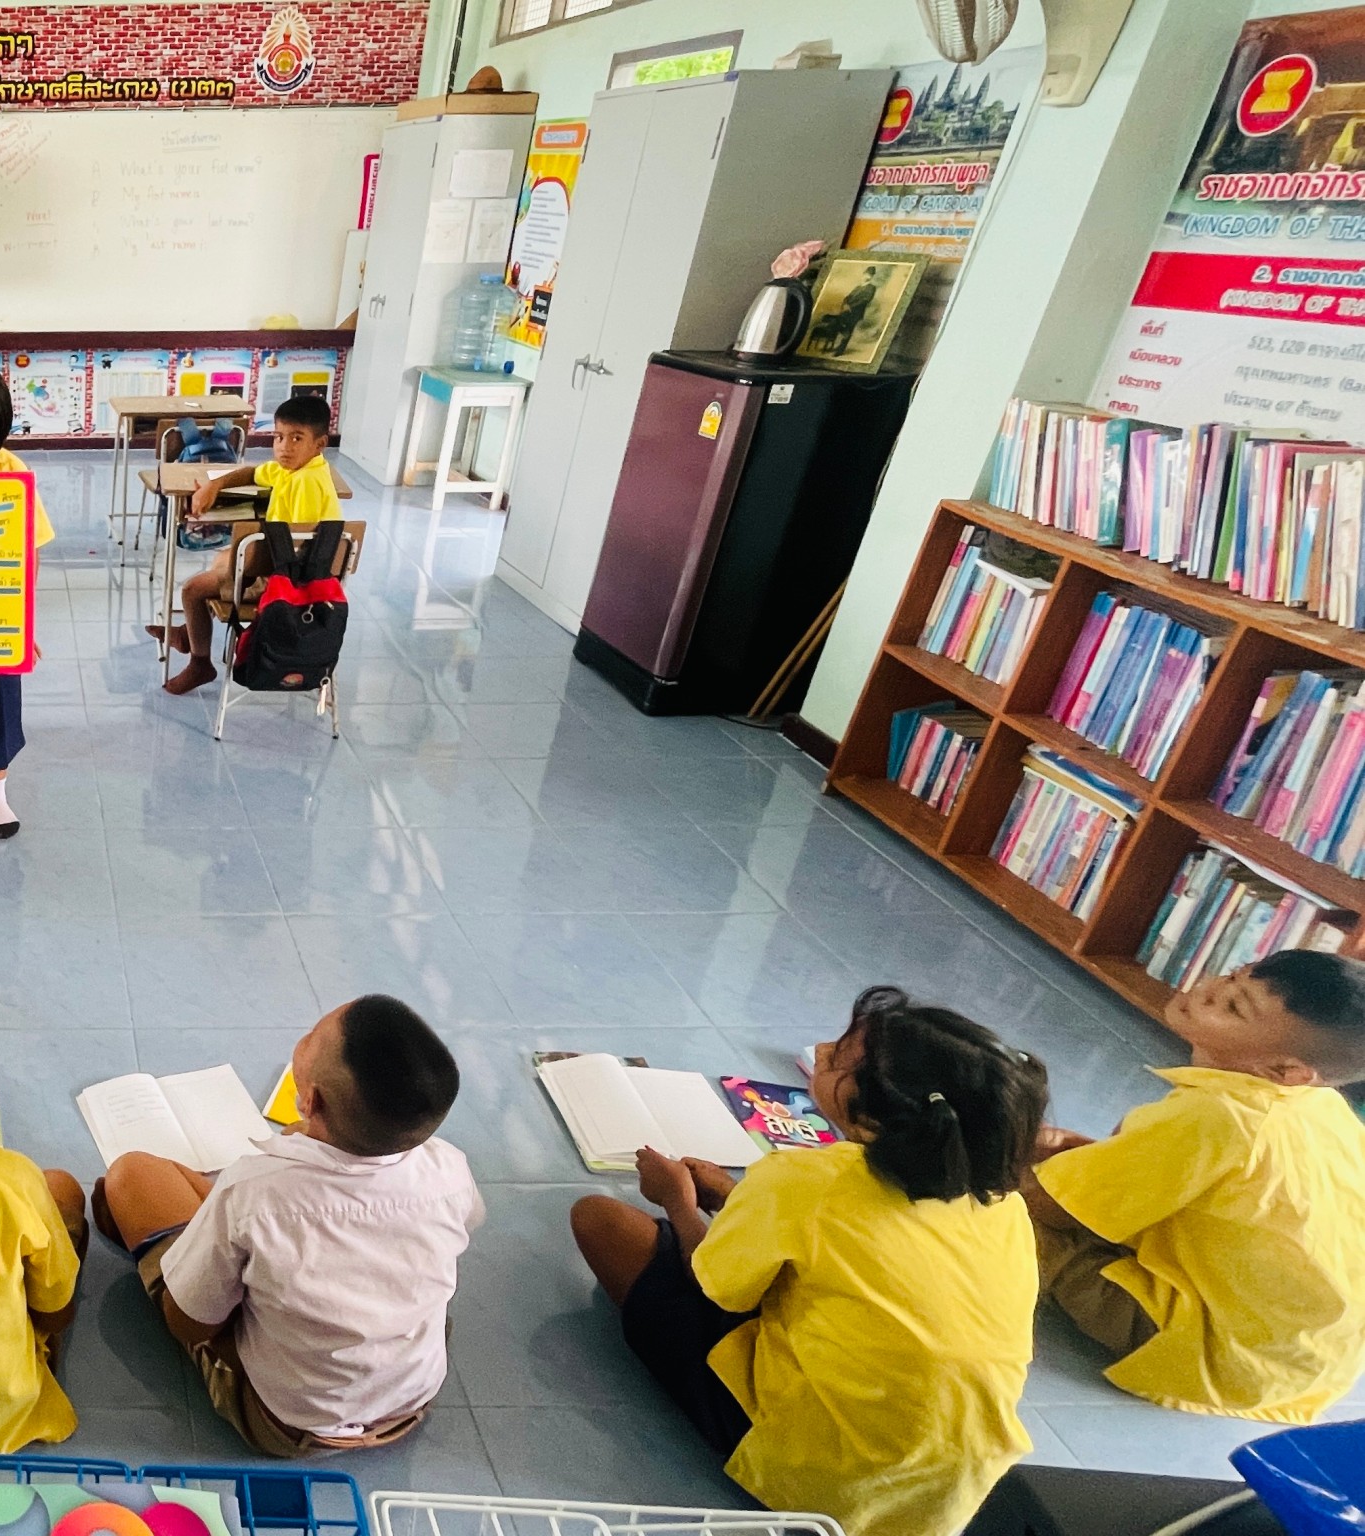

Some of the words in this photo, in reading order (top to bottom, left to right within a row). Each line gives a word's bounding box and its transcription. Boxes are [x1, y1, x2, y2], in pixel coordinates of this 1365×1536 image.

[174, 162, 202, 185] your
[1198, 166, 1365, 200] ราชอาณาจักร
[861, 195, 896, 212] GDOM
[1183, 213, 1279, 237] (KINGDOM
[1290, 214, 1319, 237] OF
[1220, 291, 1302, 312] (KINGDOM
[1305, 294, 1335, 313] OF
[1118, 373, 1162, 391] ประชากร
[1339, 369, 1365, 392] (Ba
